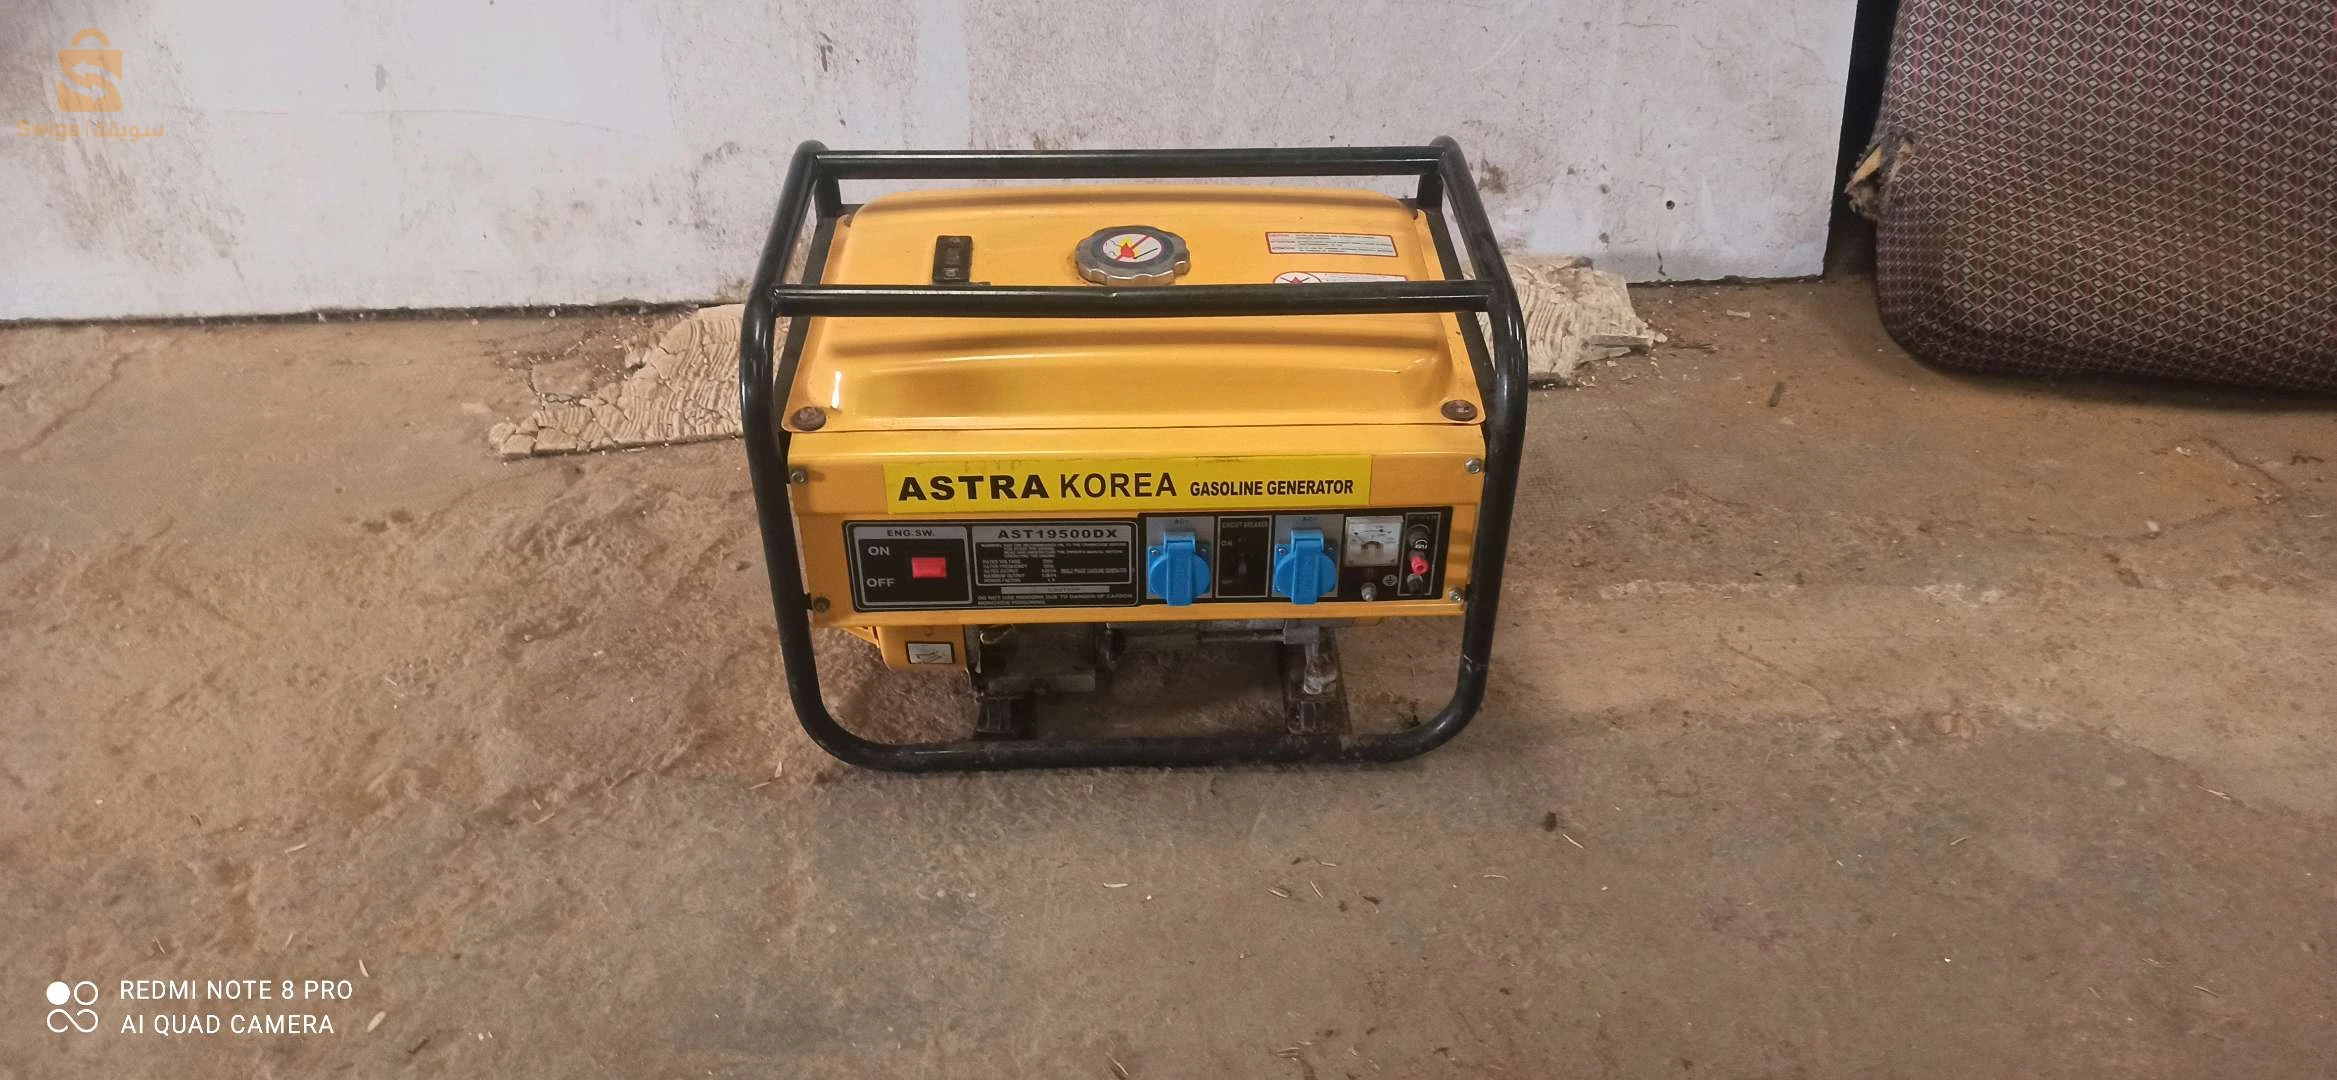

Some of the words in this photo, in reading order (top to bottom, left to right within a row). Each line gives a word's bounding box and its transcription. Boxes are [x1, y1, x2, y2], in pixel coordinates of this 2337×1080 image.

[898, 473, 1050, 501] ASTRA
[1059, 472, 1178, 499] KOREA
[1190, 480, 1264, 497] GASOLINE
[1266, 479, 1354, 496] GENERATOR
[886, 529, 936, 537] ENG.SW.
[998, 528, 1118, 539] AST19500DX
[868, 546, 890, 556] ON
[866, 578, 895, 588] OFF
